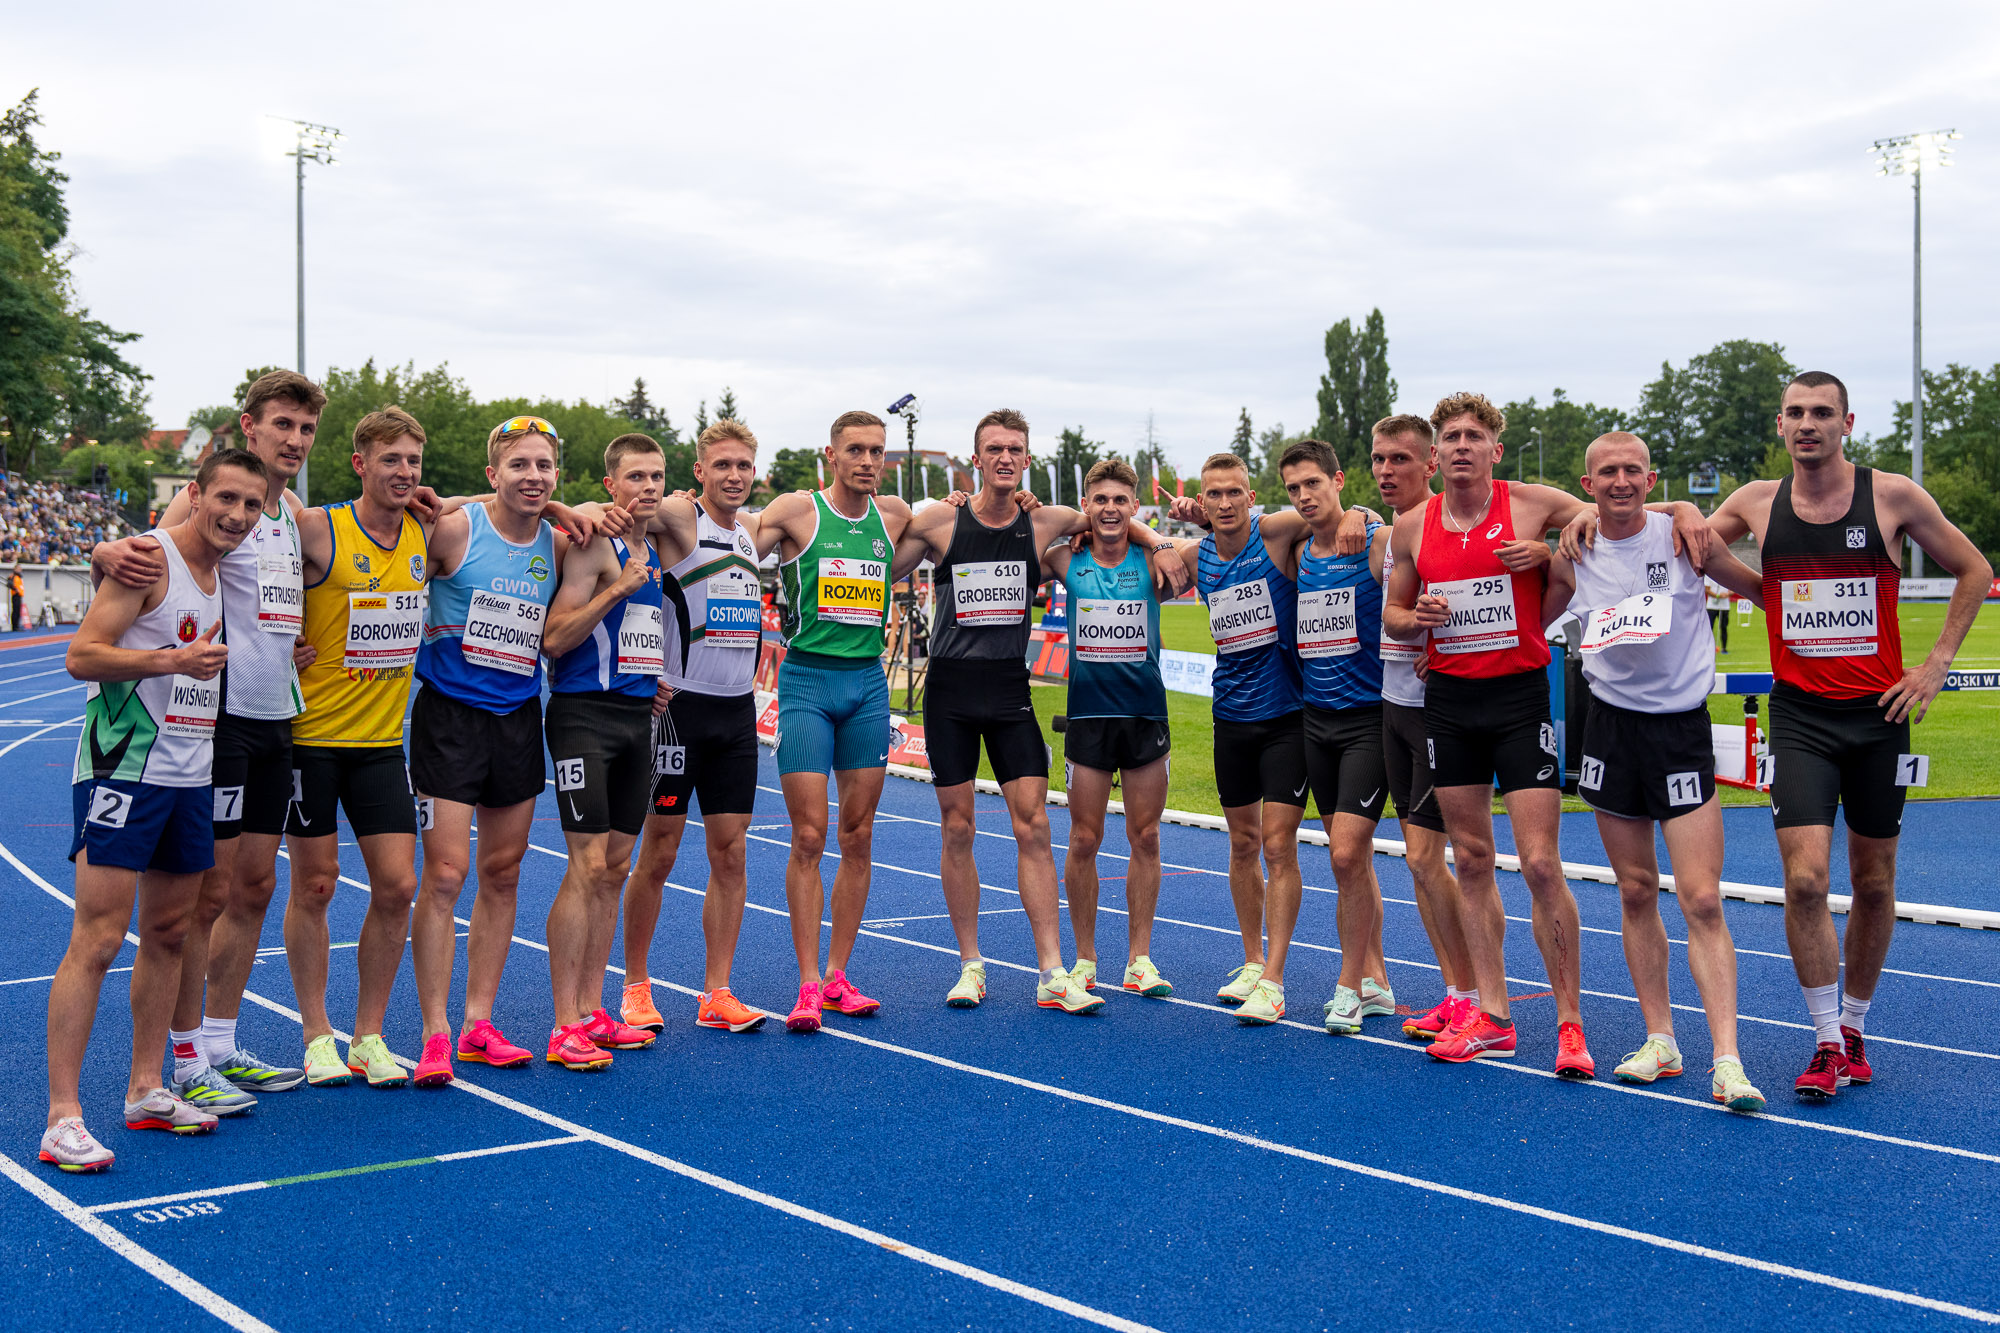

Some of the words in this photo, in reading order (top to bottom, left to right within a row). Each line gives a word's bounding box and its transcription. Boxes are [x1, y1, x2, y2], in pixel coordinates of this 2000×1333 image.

[860, 564, 882, 578] 100
[994, 564, 1020, 577] 610
[491, 577, 539, 598] GWDA
[744, 584, 758, 597] 177
[824, 584, 882, 602] ROZMYS
[958, 587, 1024, 604] GROBERSKI
[1235, 584, 1262, 601] 283
[1472, 580, 1504, 596] 295
[1834, 582, 1868, 598] 311
[395, 594, 419, 610] 511
[474, 594, 510, 610] Artisan
[1324, 591, 1350, 606] 279
[1643, 596, 1654, 606] 9
[517, 603, 540, 621] 565
[1116, 603, 1142, 616] 617
[1212, 604, 1272, 632] WASIEWICZ
[1437, 604, 1512, 628] OWALCZYK
[1299, 614, 1354, 634] KUCHARSKI
[1600, 616, 1652, 638] KULIK
[1786, 609, 1873, 630] MARMON
[351, 622, 420, 640] BOROWSKI
[469, 620, 540, 650] CZECHOWICZ
[1079, 624, 1146, 639] KOMODA
[464, 654, 488, 663] GORZÓW
[1944, 676, 1980, 687] OLSKI
[1984, 675, 1994, 686] W
[659, 750, 684, 770] 16
[559, 764, 583, 786] 15
[1584, 762, 1600, 784] 11
[1758, 759, 1766, 784] 1
[1906, 757, 1919, 784] 1
[1672, 777, 1697, 800] 11
[97, 793, 124, 824] 2
[222, 790, 238, 818] 7
[133, 1201, 222, 1223] 800
